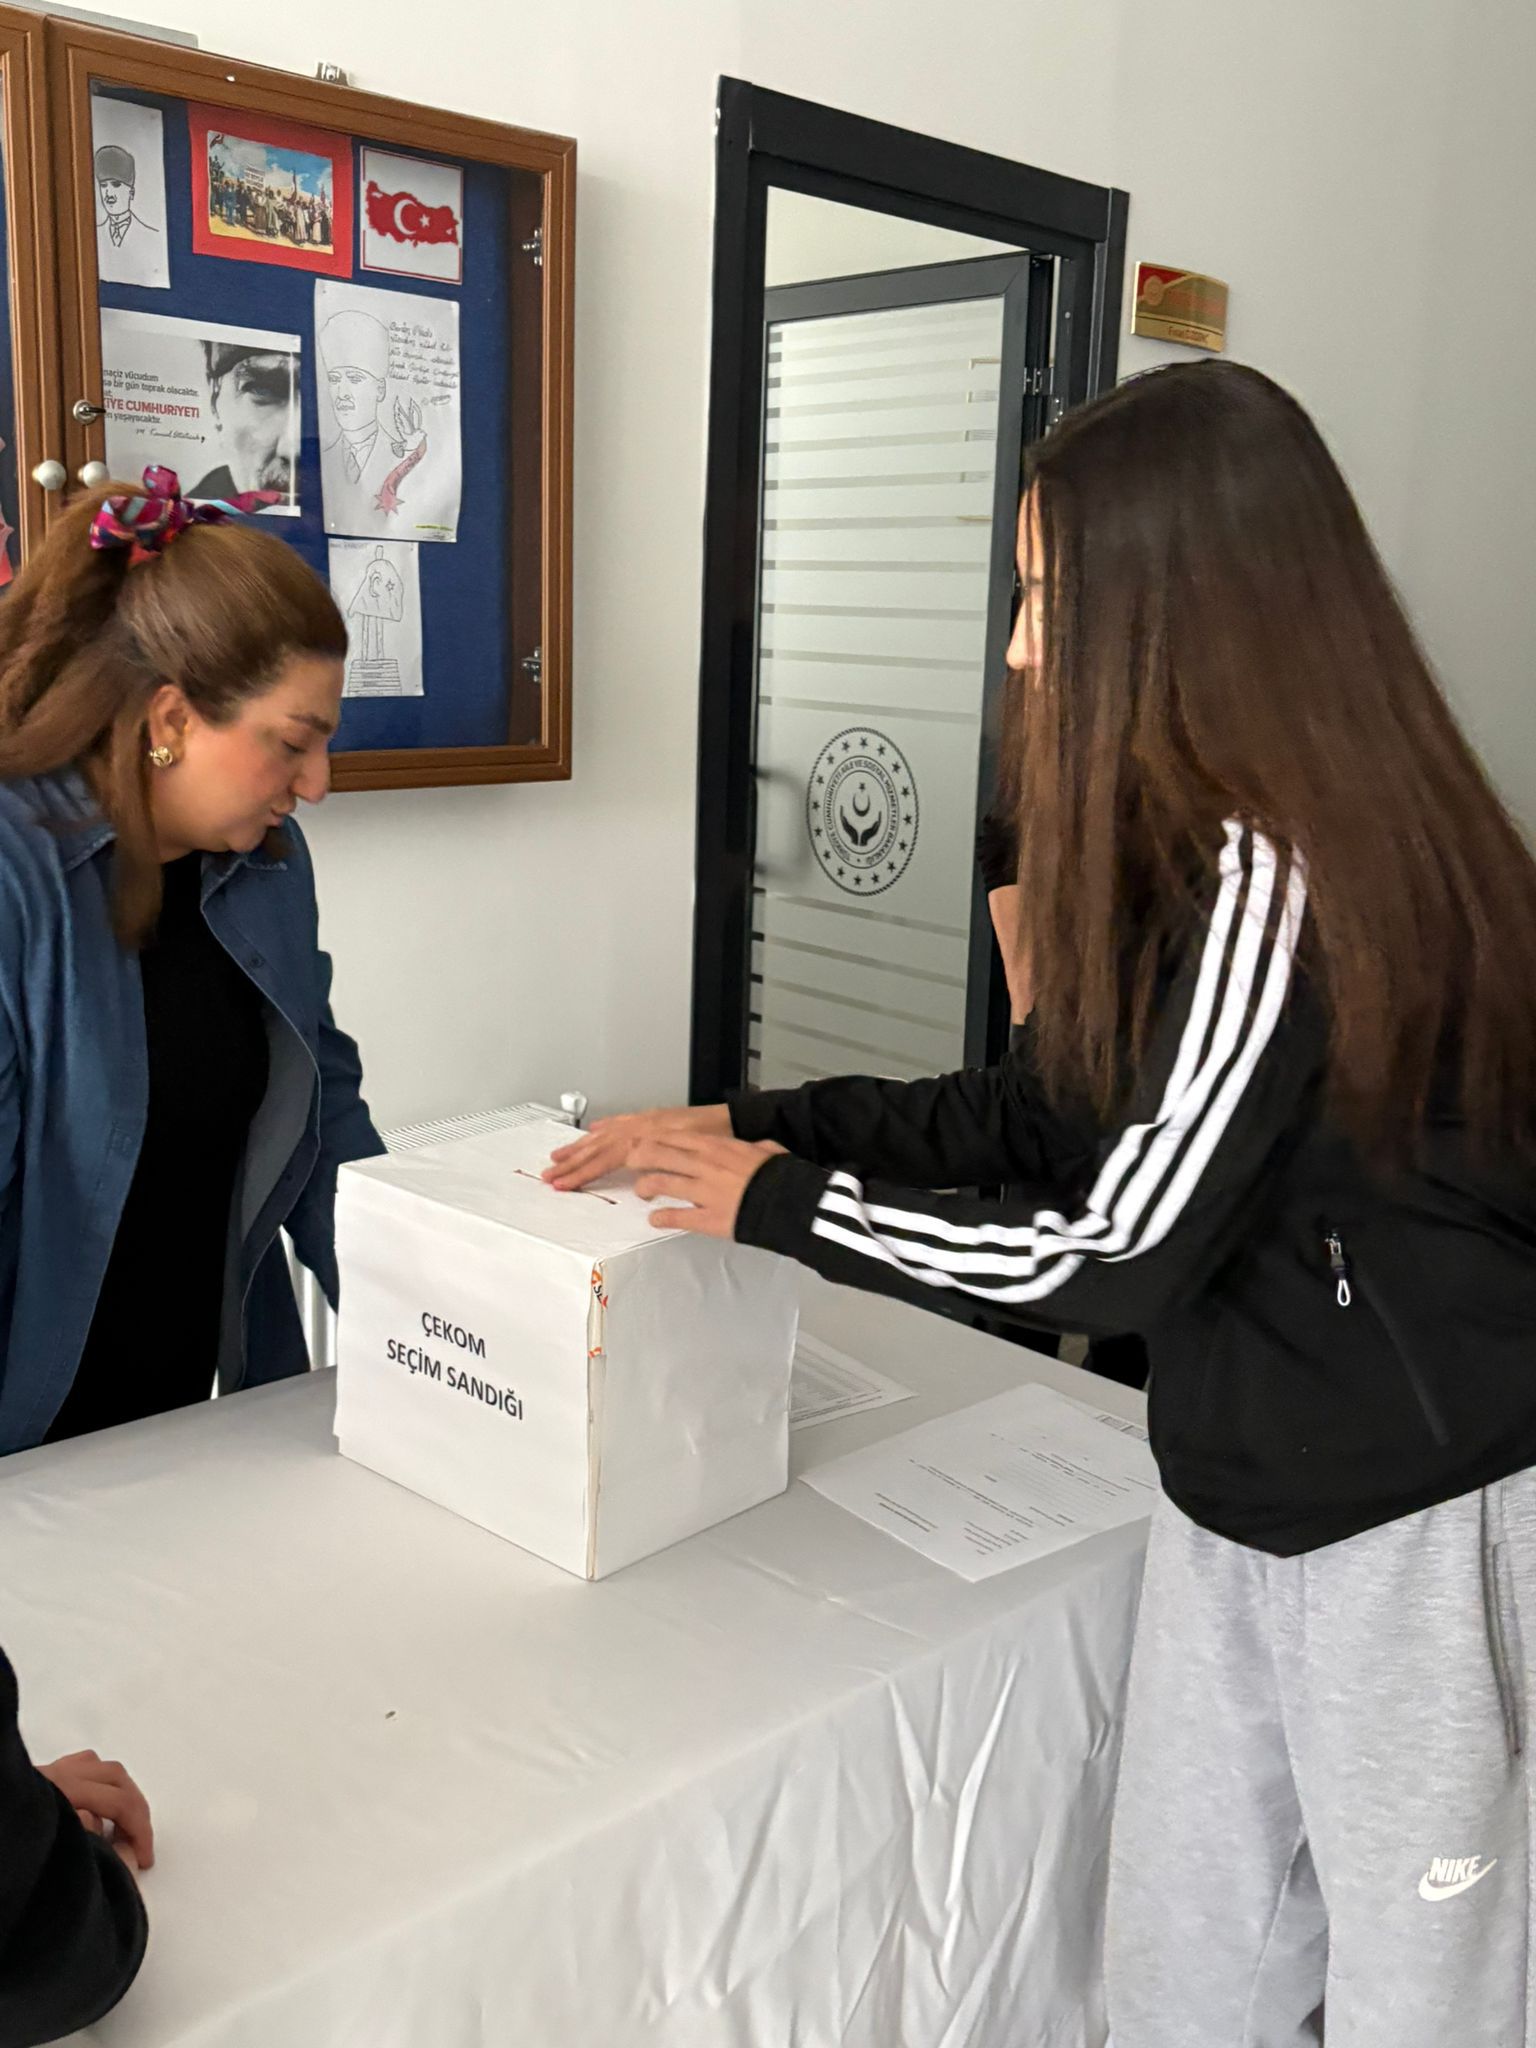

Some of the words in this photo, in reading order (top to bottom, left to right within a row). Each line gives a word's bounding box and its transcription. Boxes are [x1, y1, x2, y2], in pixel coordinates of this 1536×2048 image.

[114, 377, 124, 387] bir
[125, 381, 139, 390] gün
[142, 384, 165, 394] toprak
[421, 1311, 486, 1359] ÇEKOM
[387, 1339, 441, 1381] SEÇİM
[447, 1366, 523, 1420] SANDIĞI
[1428, 1855, 1482, 1884] NIKE
